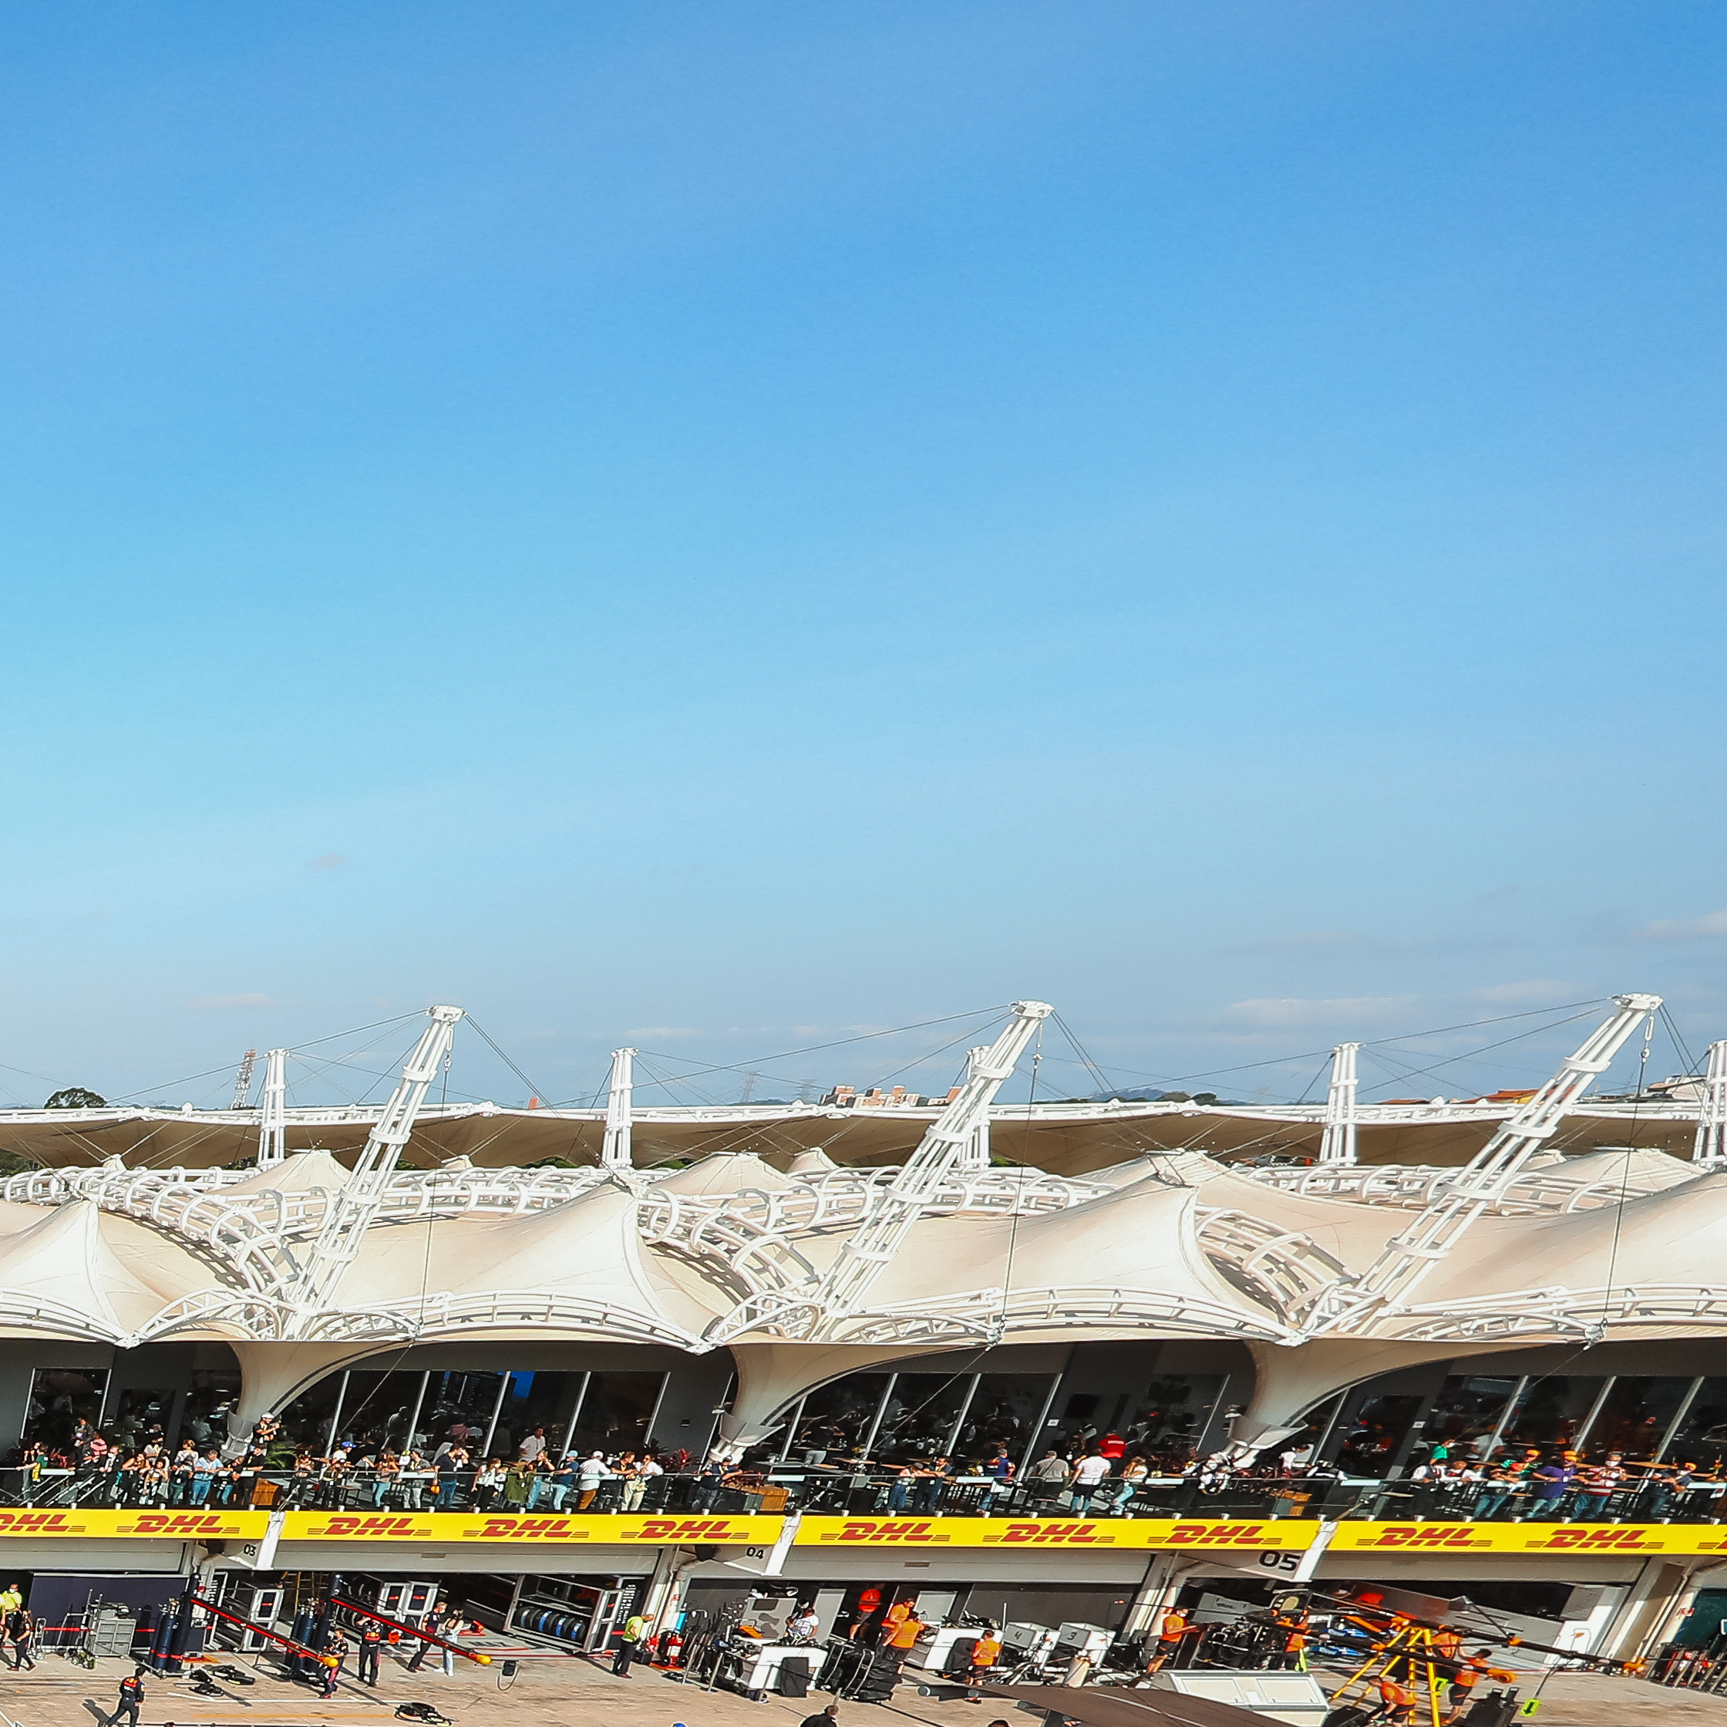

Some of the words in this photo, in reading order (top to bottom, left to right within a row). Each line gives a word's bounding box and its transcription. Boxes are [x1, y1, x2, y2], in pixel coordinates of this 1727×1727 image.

[136, 1517, 220, 1534] DHL
[326, 1519, 411, 1536] DHL
[482, 1520, 568, 1538] DHL
[640, 1521, 728, 1539] DHL
[840, 1523, 930, 1541] DHL
[1003, 1525, 1093, 1543] DHL
[1168, 1526, 1260, 1545] DHL
[1377, 1528, 1470, 1547] DHL
[1547, 1530, 1641, 1549] DHL
[243, 1544, 256, 1556] 03
[746, 1547, 764, 1559] 04
[1259, 1550, 1301, 1571] 05
[1014, 1631, 1022, 1640] 4
[1067, 1632, 1077, 1640] 3
